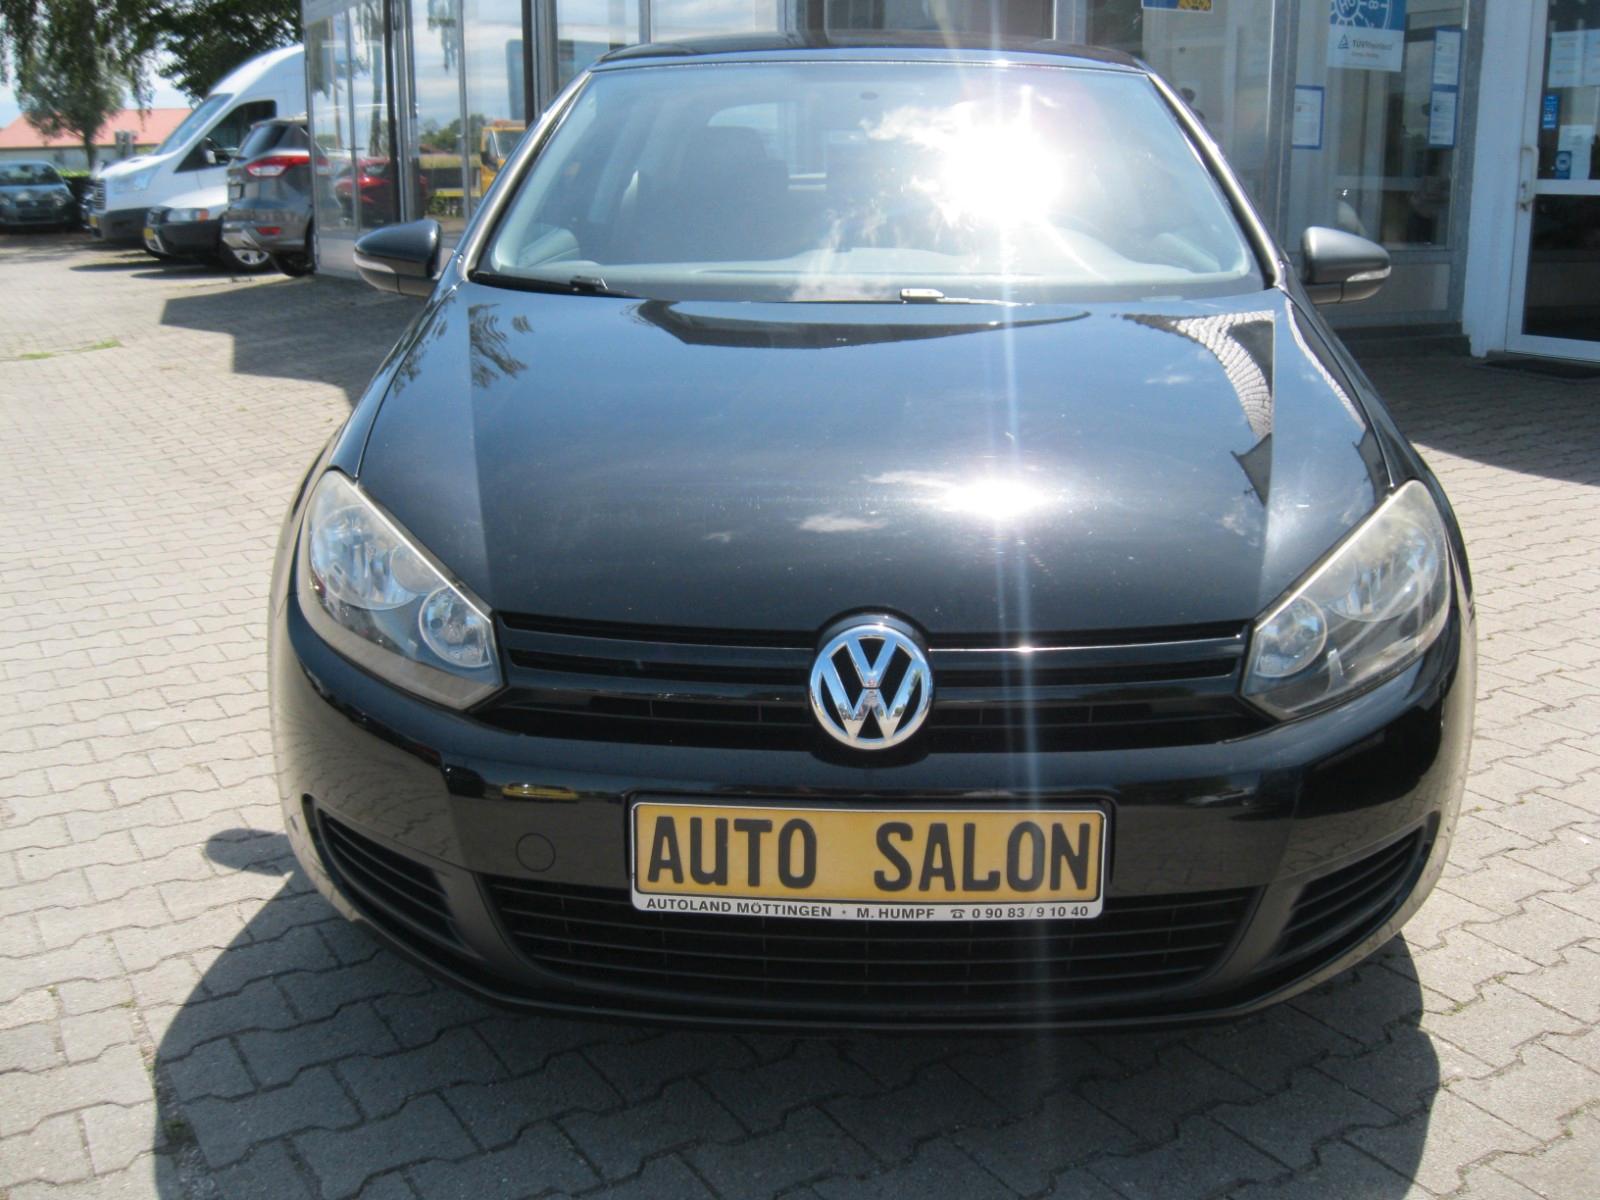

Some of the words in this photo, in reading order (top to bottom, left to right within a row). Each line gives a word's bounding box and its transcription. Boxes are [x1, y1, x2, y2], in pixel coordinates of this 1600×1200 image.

[647, 815, 818, 889] AUTO
[873, 820, 1091, 892] SALON
[646, 898, 732, 913] AUTOLAND
[736, 901, 832, 917] MÖTTINGEN
[878, 907, 935, 919] HUMPF
